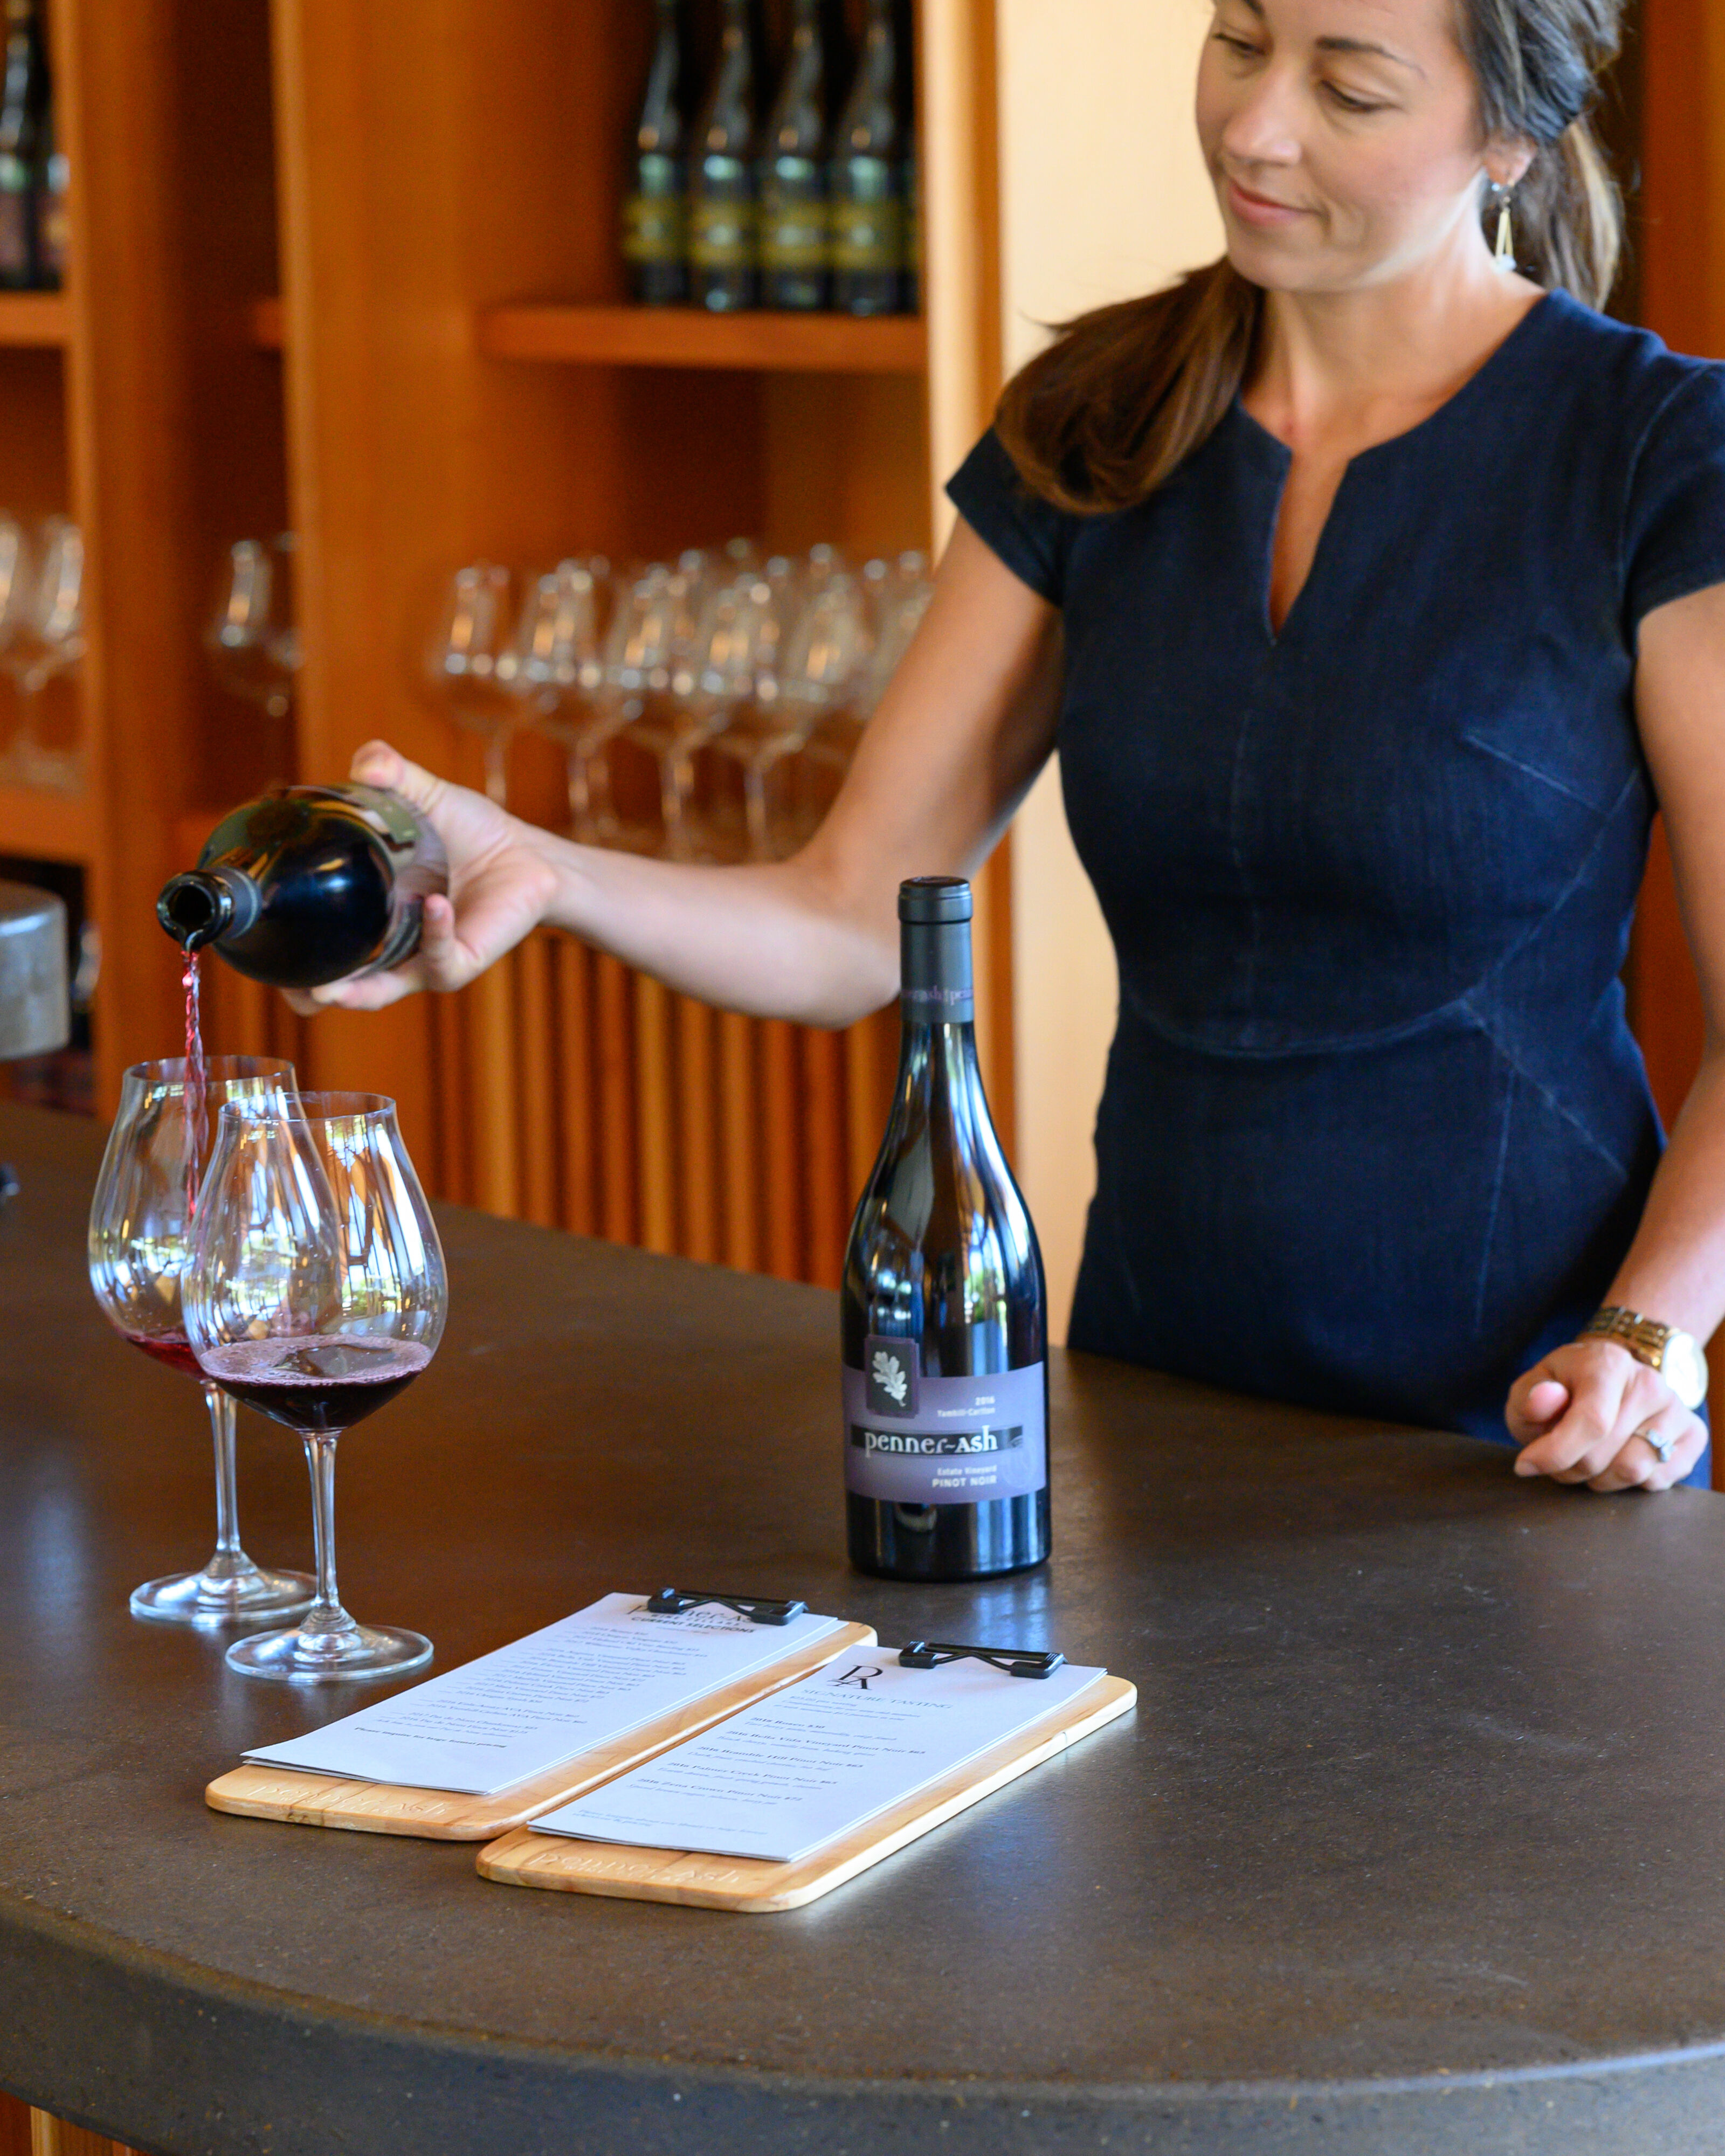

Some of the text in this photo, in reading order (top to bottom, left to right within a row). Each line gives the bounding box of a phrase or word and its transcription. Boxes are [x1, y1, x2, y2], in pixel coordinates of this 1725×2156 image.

[975, 1395, 995, 1406] 2016
[937, 1464, 997, 1476] Estate Vineyard
[932, 1475, 997, 1488] PINOT NOIR
[631, 1616, 684, 1626] CURRENT
[686, 1622, 756, 1633] SELECTIONS
[803, 1689, 953, 1709] SIGNATURE TASTING
[805, 1739, 850, 1747] Vineyard
